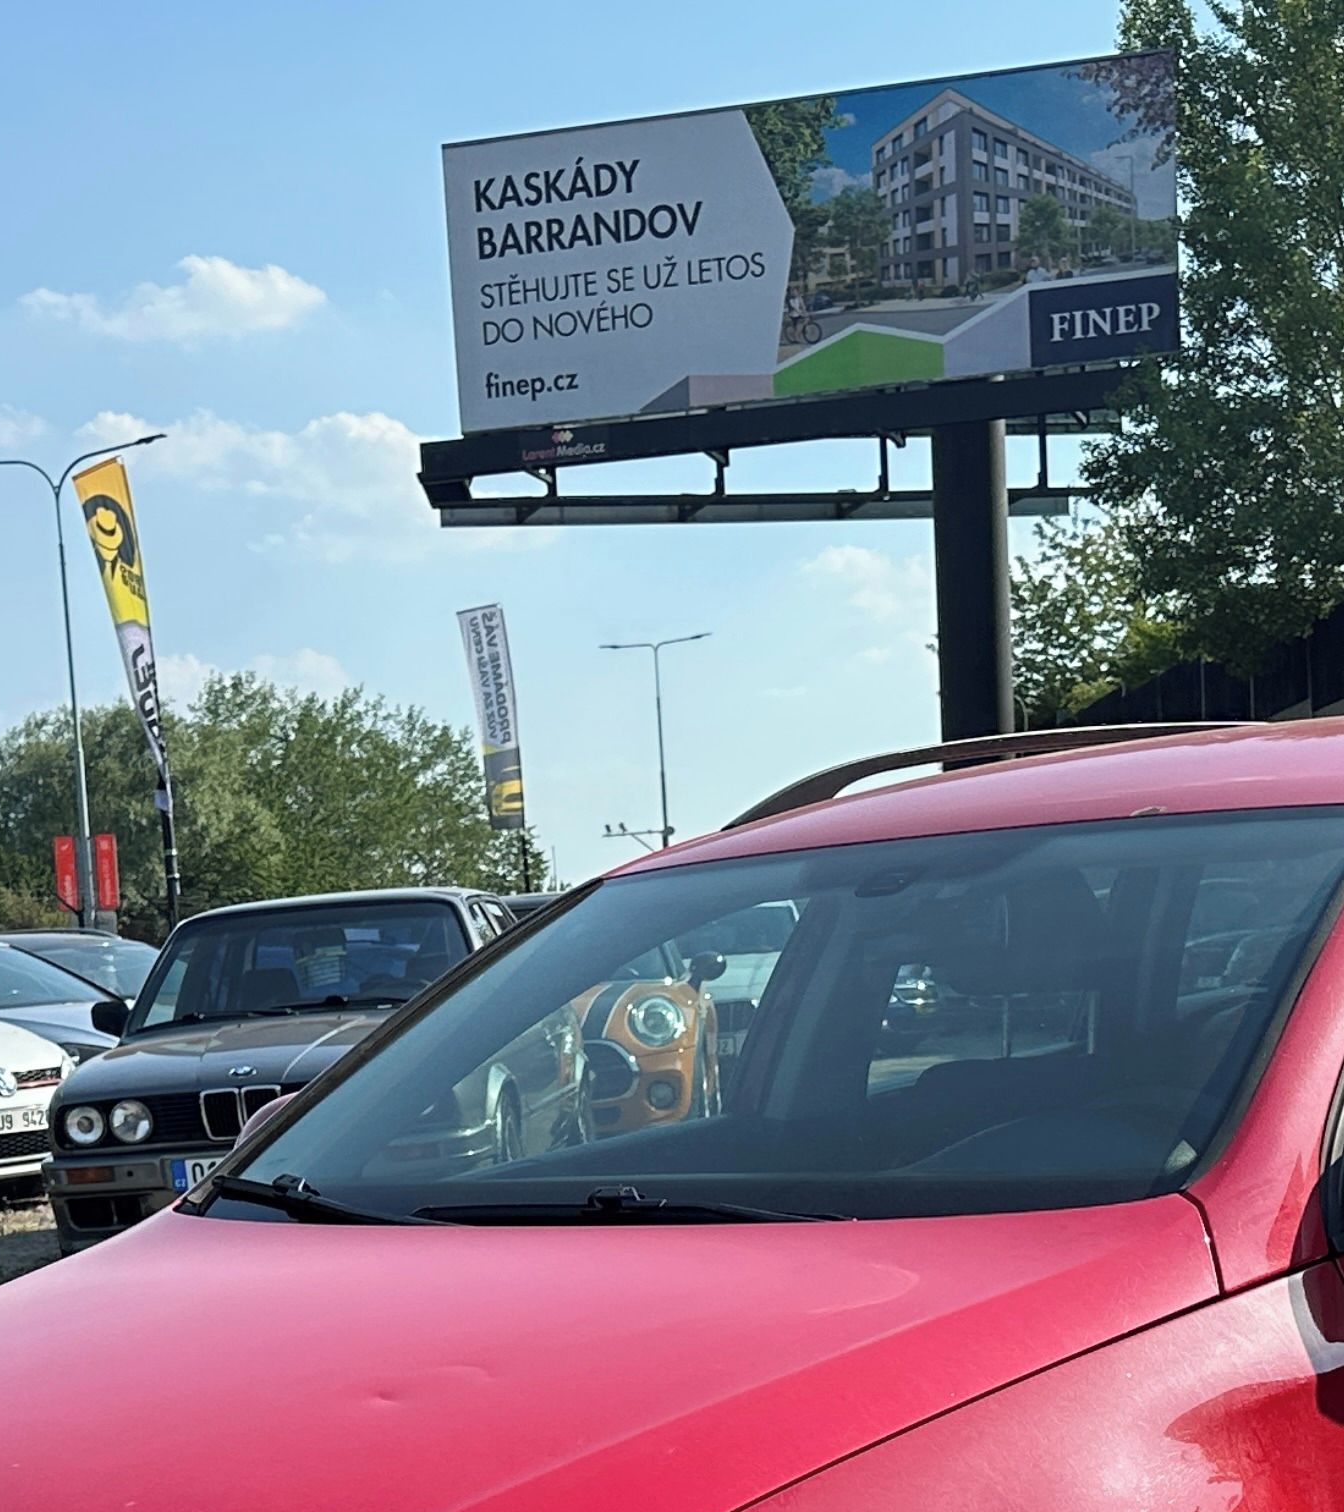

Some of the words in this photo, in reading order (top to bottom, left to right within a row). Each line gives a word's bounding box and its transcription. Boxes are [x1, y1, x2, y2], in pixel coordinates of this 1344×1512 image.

[474, 156, 640, 213] KASKÁDY
[477, 201, 703, 260] BARRANDOV
[480, 273, 598, 309] STĚHUJTE
[607, 267, 634, 294] SE
[643, 255, 679, 291] UŽ
[687, 252, 766, 286] LETOS
[483, 318, 524, 346] DO
[533, 300, 653, 340] NOVÉHO
[1050, 302, 1161, 342] FINEP
[486, 372, 579, 401] finep.cz
[22, 1109, 50, 1128] 942
